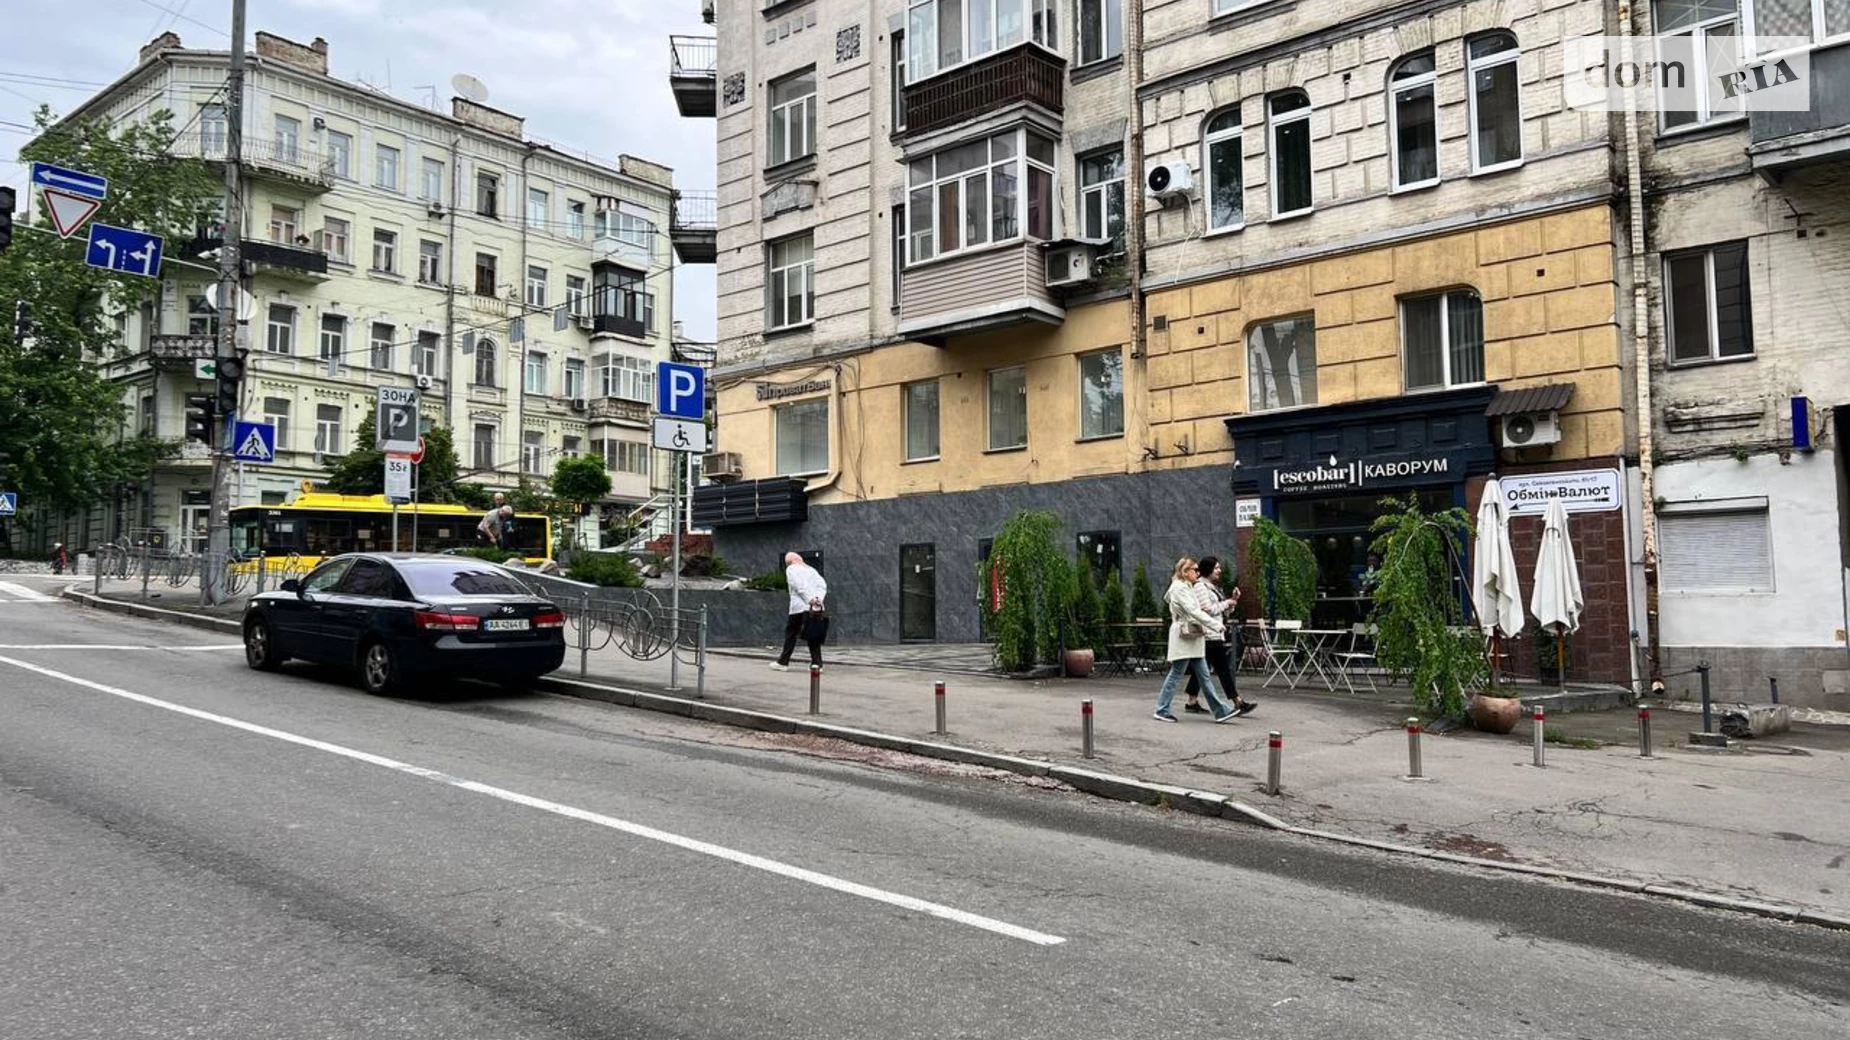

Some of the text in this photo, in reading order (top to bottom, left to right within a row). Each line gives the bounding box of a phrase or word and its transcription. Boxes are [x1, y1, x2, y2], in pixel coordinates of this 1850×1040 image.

[382, 389, 416, 403] ЗОНА
[670, 368, 696, 412] P
[389, 407, 408, 436] P
[1365, 458, 1448, 478] КАВОРУМ
[1557, 485, 1610, 498] Валют
